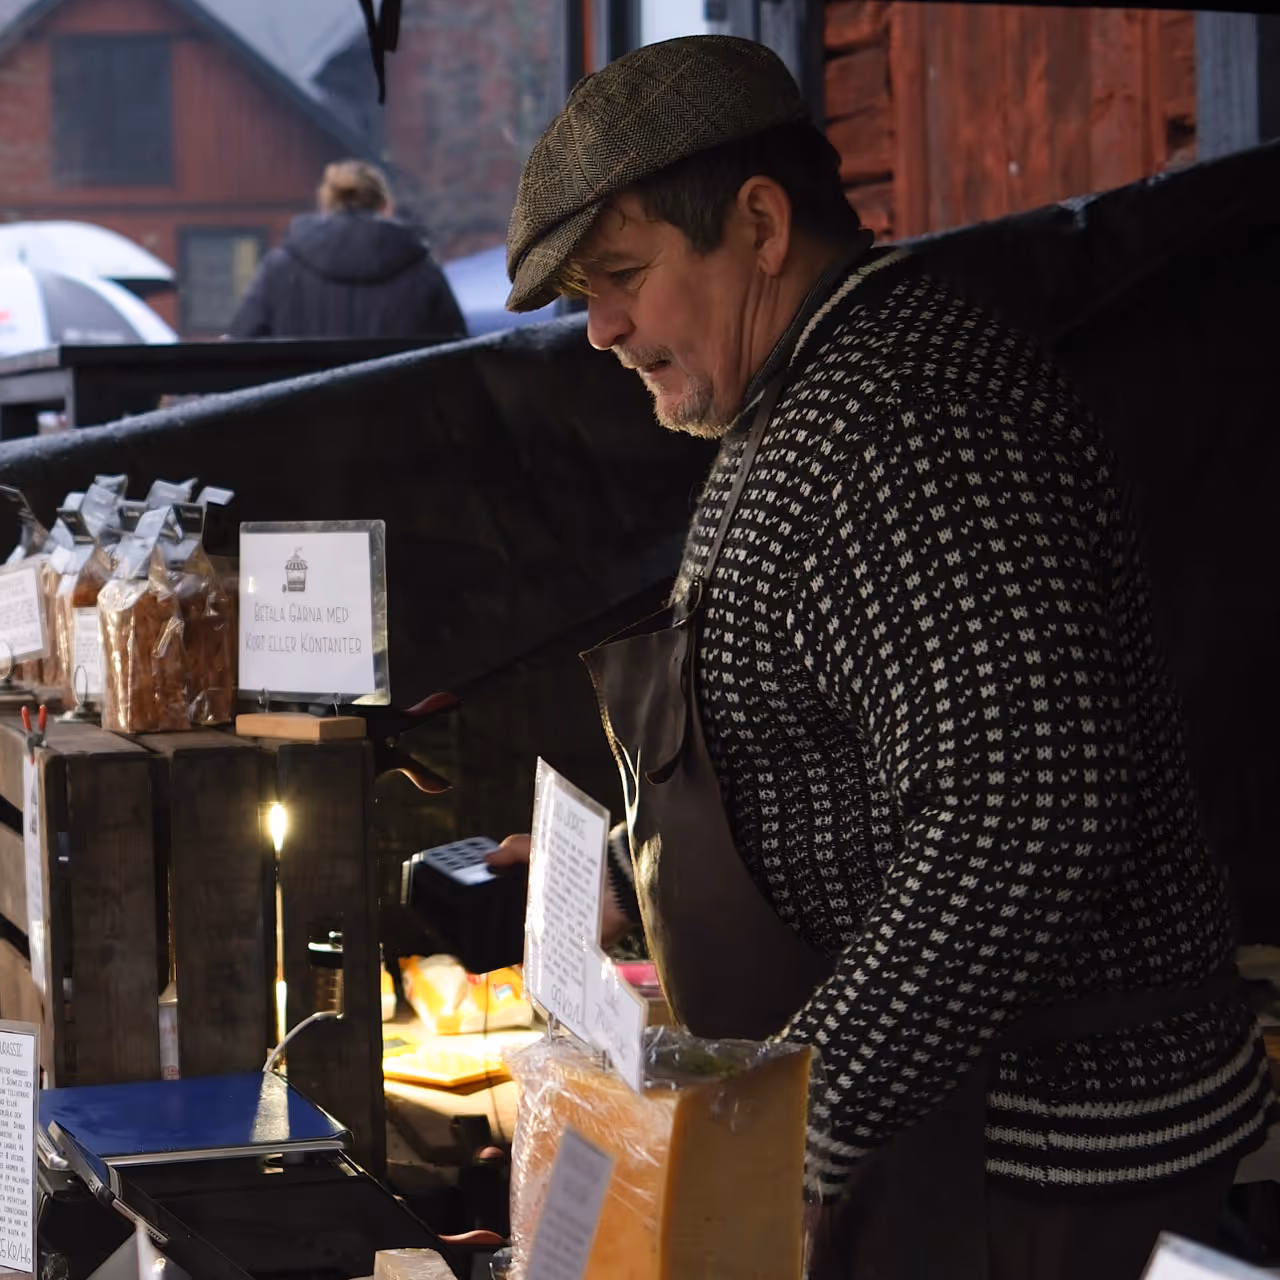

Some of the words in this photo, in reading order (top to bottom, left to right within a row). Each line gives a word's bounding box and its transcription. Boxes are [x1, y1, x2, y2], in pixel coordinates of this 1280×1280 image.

[254, 601, 286, 622] BETALA
[326, 606, 349, 624] MED
[245, 631, 266, 652] KORT
[268, 634, 296, 653] ELLER
[300, 631, 362, 655] KONTANTER
